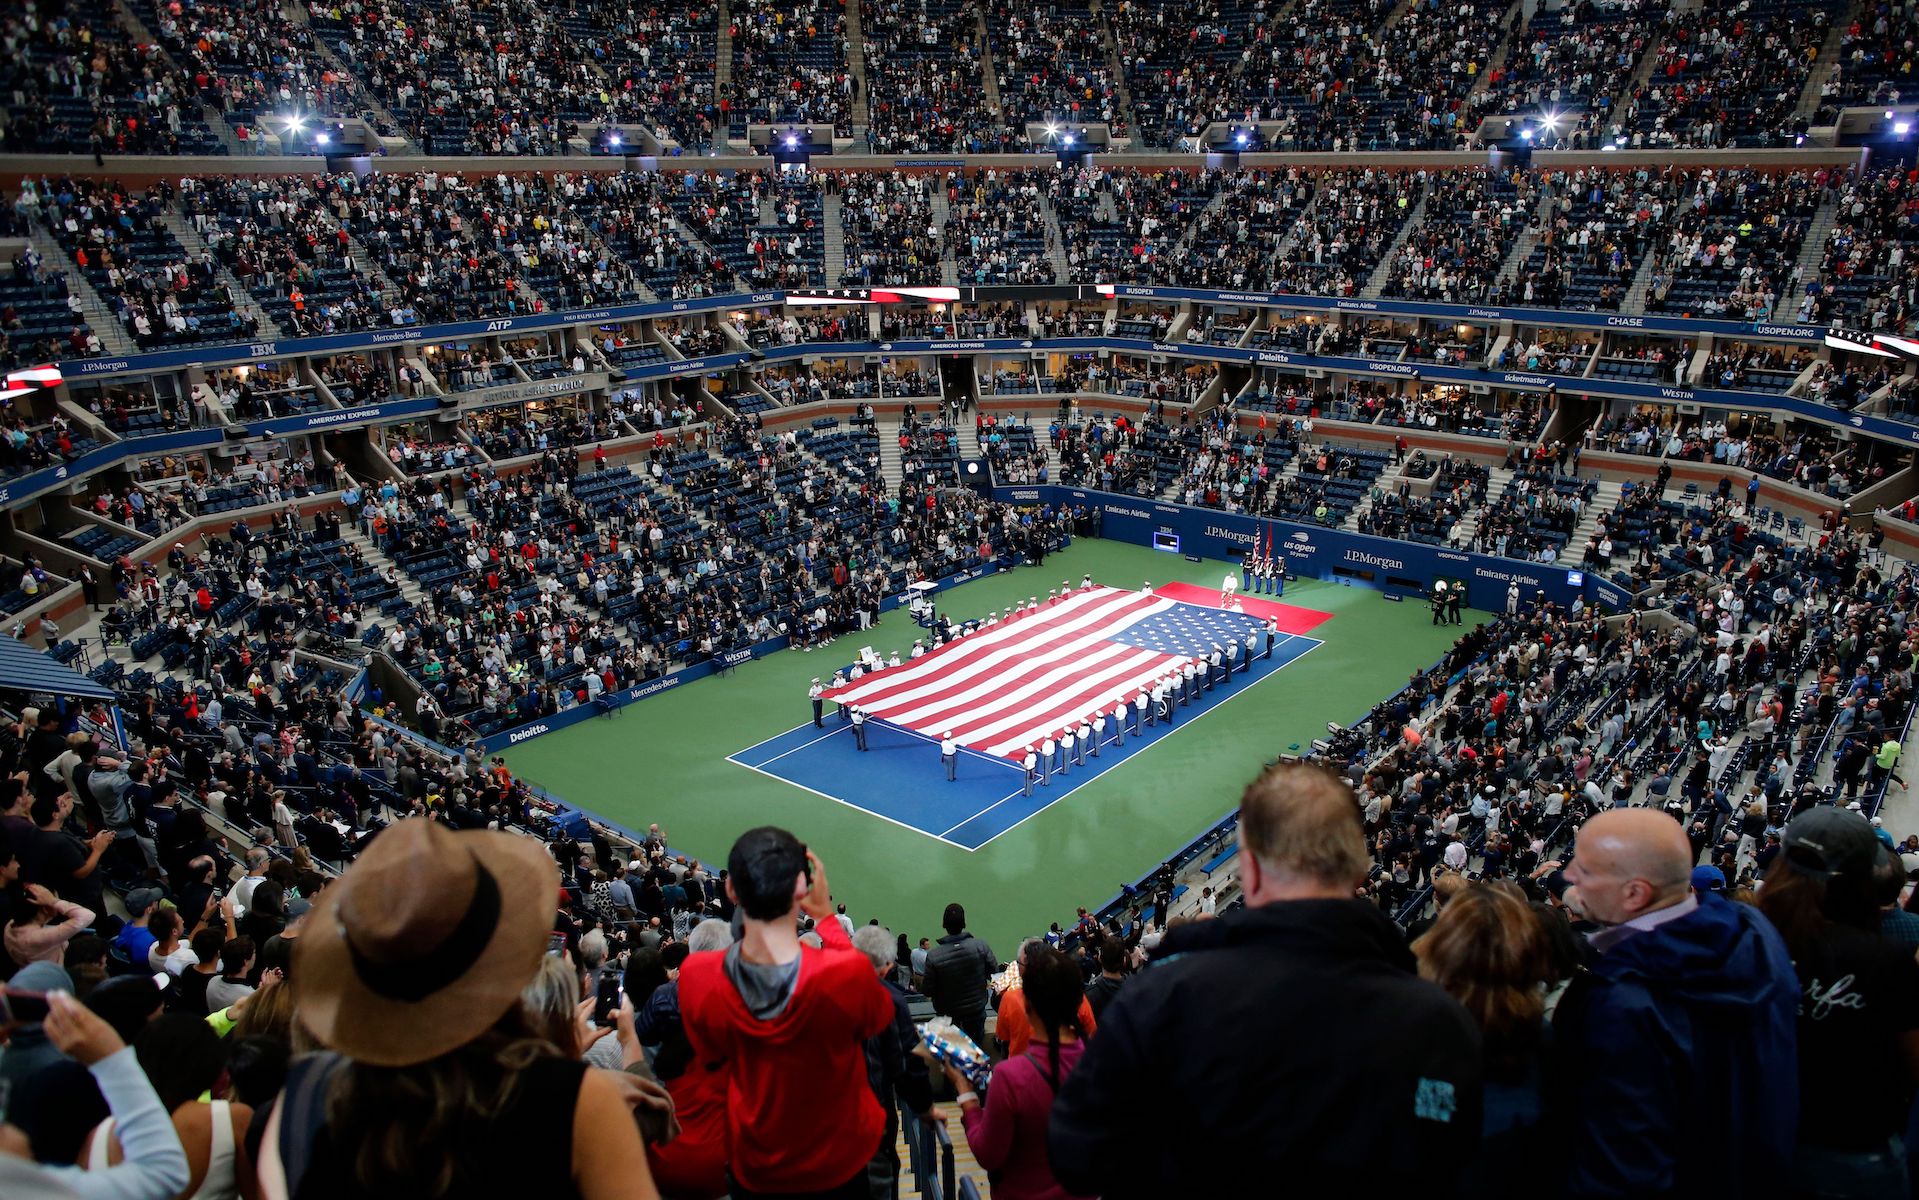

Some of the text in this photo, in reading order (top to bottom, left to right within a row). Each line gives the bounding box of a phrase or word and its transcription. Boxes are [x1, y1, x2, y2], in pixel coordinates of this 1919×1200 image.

[752, 294, 774, 303] CHASE
[1218, 293, 1244, 301] AMERICAN
[1337, 301, 1359, 309] Emirates
[1467, 307, 1500, 318] J.P.Morgan
[486, 320, 512, 332] ATP
[1608, 317, 1643, 327] CHASE
[372, 330, 421, 343] Mercedes-Benz
[1757, 325, 1815, 338] USOPEN.ORG
[250, 343, 277, 357] IBM
[1152, 342, 1179, 352] Spectrum
[1258, 352, 1289, 363] Deloitte
[81, 361, 128, 373] J.P.Morgan
[690, 361, 705, 370] Airline
[1369, 361, 1412, 374] USOPEN.ORG
[1504, 373, 1548, 385] ticketmaster
[308, 408, 380, 426] AMERICAN EXPRESS
[1105, 504, 1151, 520] Emirates Airline
[1155, 504, 1180, 514] USOPEN.ORG
[1160, 526, 1173, 534] IBM
[1204, 525, 1257, 544] J.P.Morgan
[1283, 541, 1317, 554] us open
[1343, 549, 1404, 570] J.P.Morgan
[1437, 551, 1470, 562] USOPEN.ORG
[1475, 567, 1539, 588] Emirates Airline
[1597, 586, 1619, 601] AMERICAN
[1599, 592, 1618, 607] EXPRESS
[724, 648, 752, 664] WESTIN
[630, 676, 680, 700] Mercedes-Benz
[509, 724, 550, 744] Deloitte.
